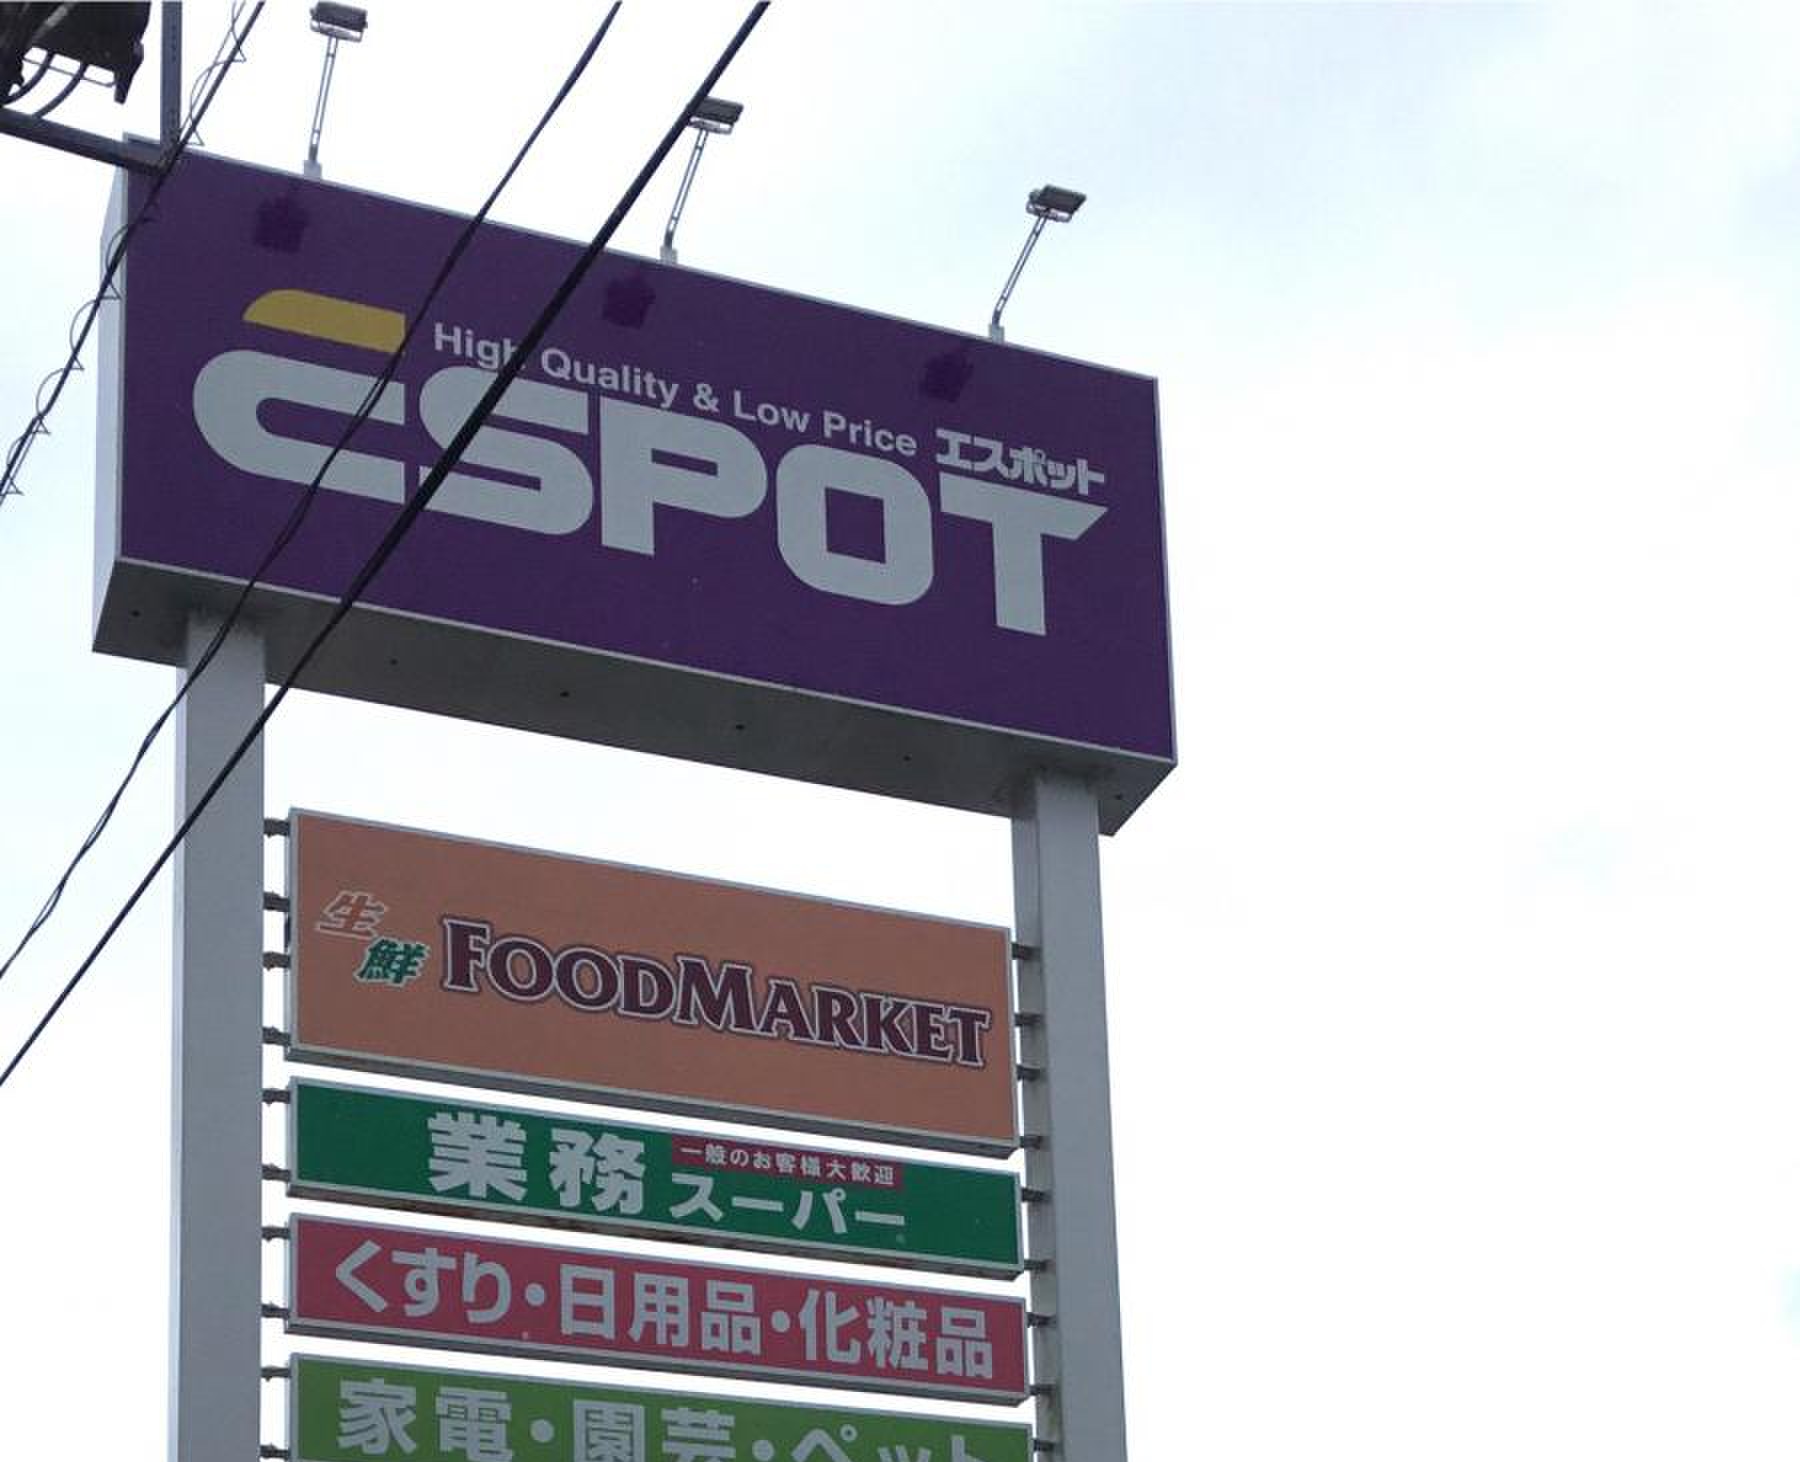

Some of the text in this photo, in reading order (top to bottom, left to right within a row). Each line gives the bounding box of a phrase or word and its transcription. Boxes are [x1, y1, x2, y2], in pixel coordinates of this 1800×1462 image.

[541, 348, 679, 408] Quality
[693, 383, 720, 414] &
[733, 390, 810, 433] Low
[823, 410, 918, 456] Price
[193, 288, 1108, 636] ESPOT
[935, 427, 1105, 496] エスポット
[680, 1143, 897, 1187] 一般のお客様大歓迎
[334, 1239, 994, 1381] くすり・日用品・化粧品
